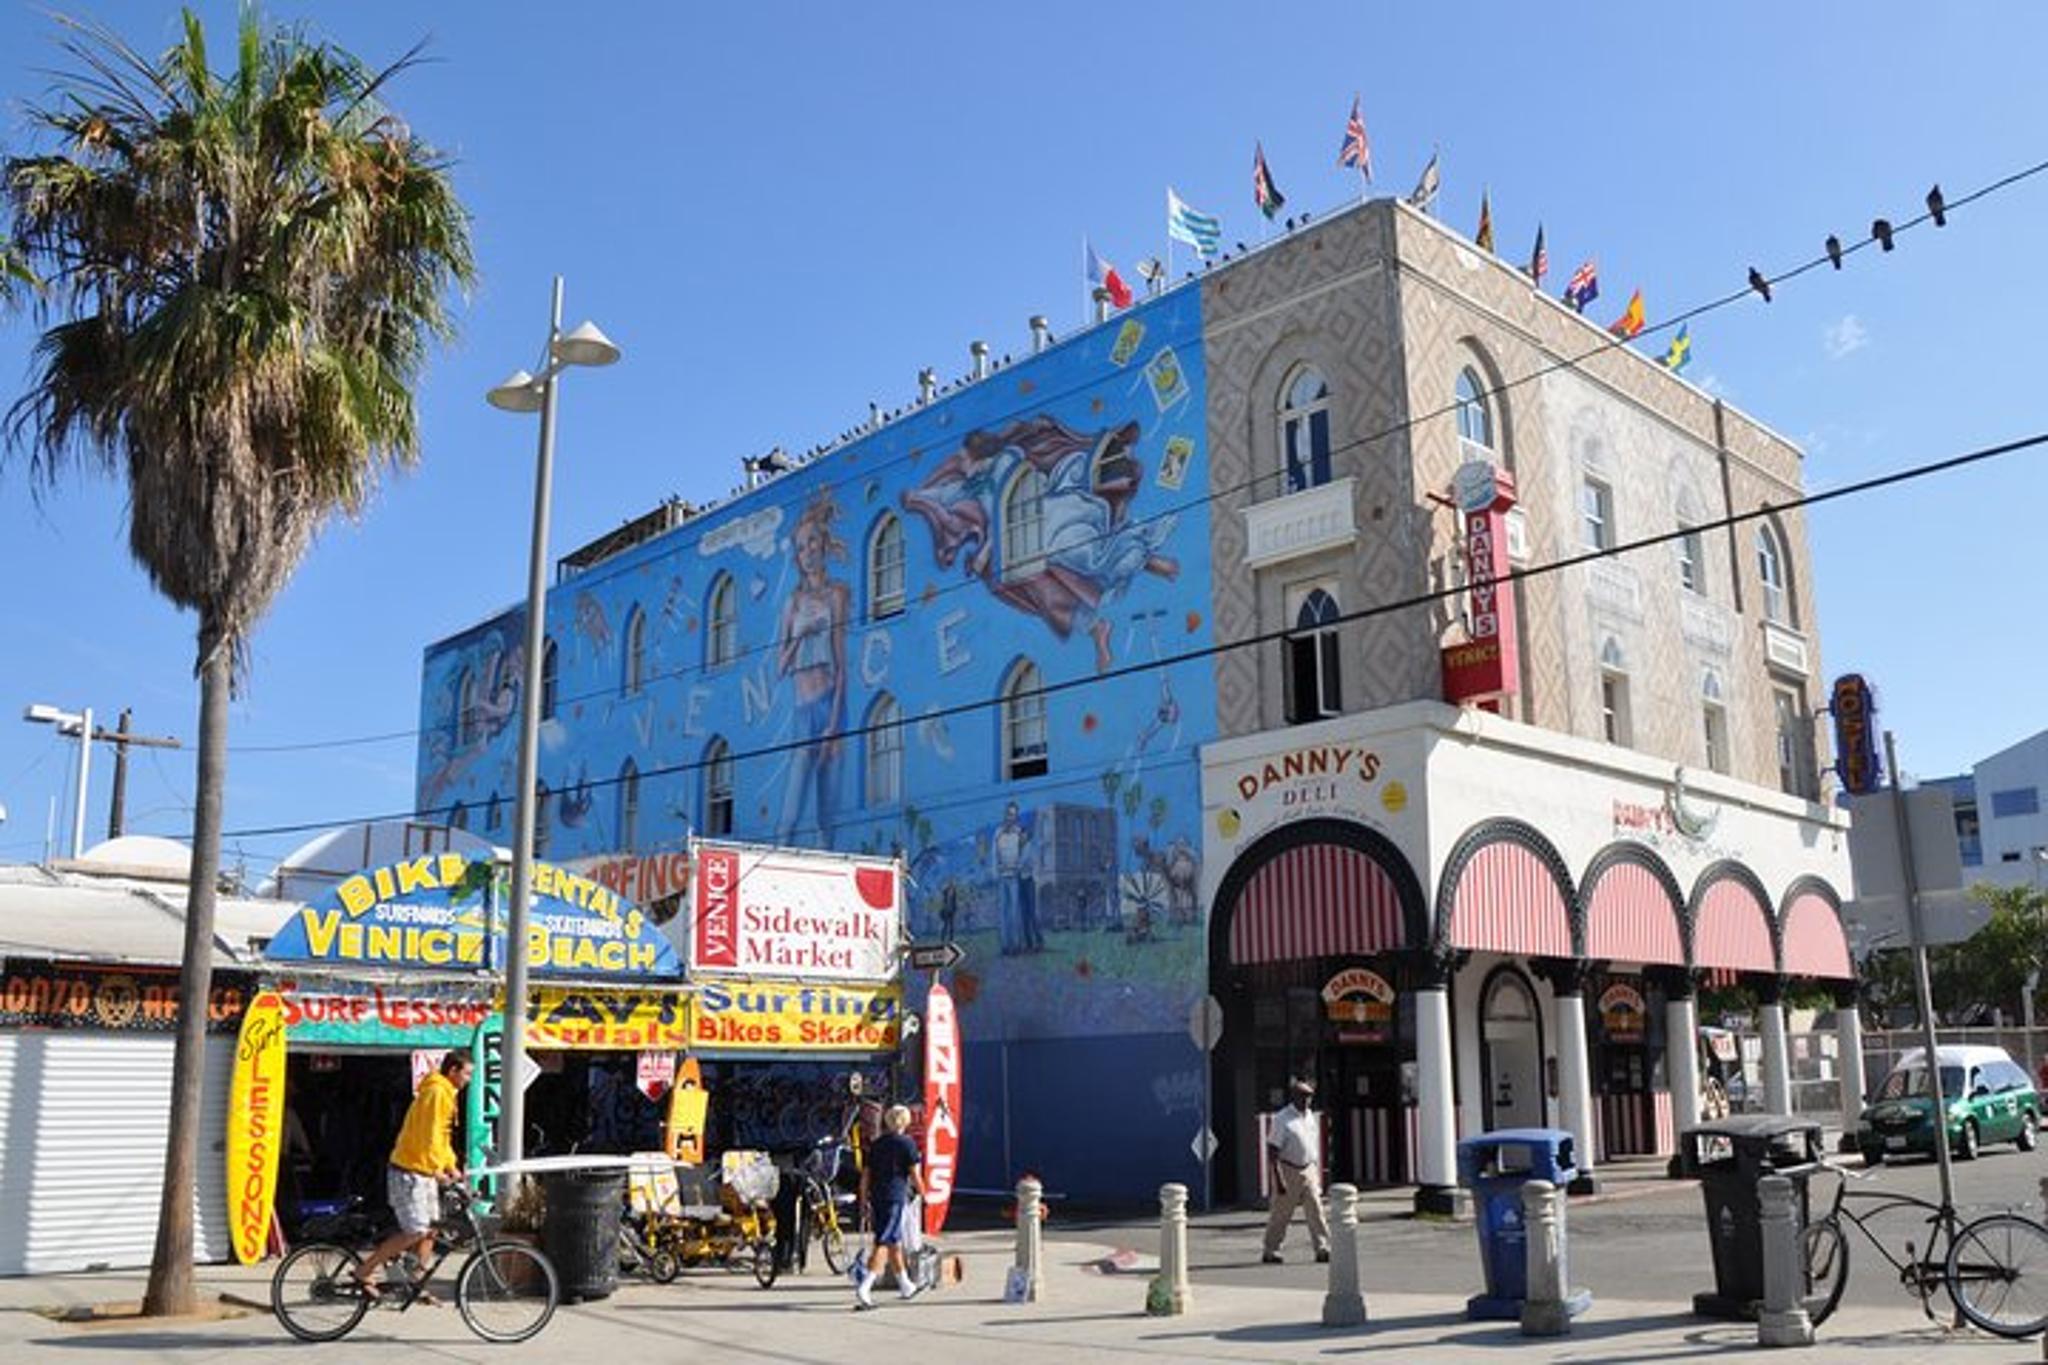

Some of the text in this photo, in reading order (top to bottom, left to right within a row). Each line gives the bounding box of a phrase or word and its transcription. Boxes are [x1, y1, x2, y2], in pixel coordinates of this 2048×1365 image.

[1237, 748, 1381, 801] DANNY'S
[336, 852, 467, 918] BIKE
[706, 857, 730, 957] VENICE
[302, 908, 656, 971] VENICE BEACH
[743, 904, 880, 940] Sidewalk
[746, 936, 855, 974] Market
[696, 1016, 895, 1045] Bikes Skates
[702, 984, 896, 1022] Surfing
[926, 993, 957, 1205] RENTALS
[241, 1053, 270, 1258] LESSONS
